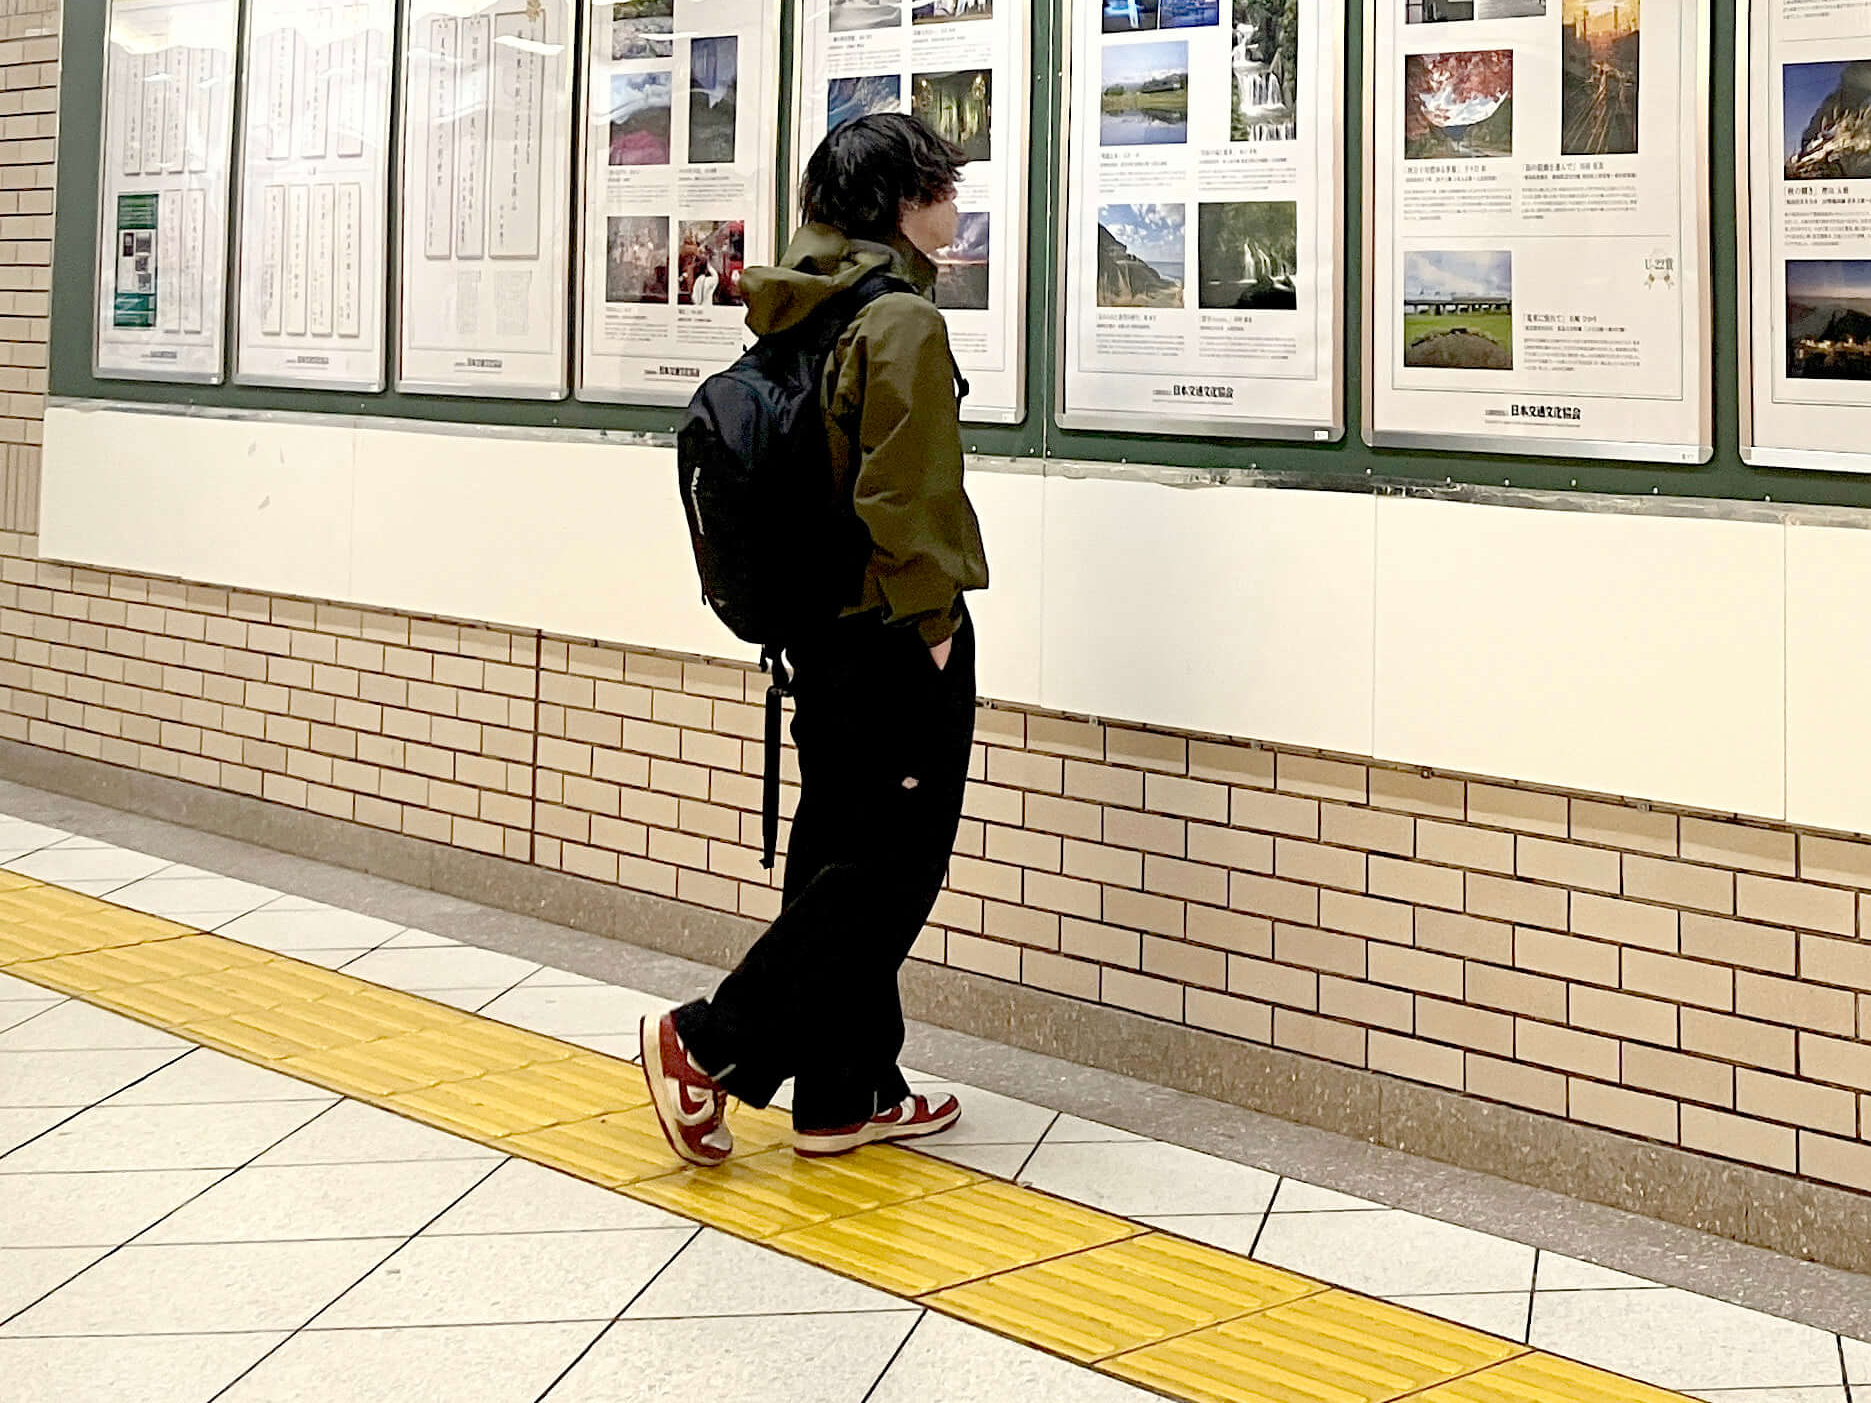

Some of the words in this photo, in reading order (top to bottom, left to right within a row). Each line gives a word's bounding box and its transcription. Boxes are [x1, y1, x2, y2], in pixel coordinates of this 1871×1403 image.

[1511, 404, 1581, 421] 日本交通文化協会
